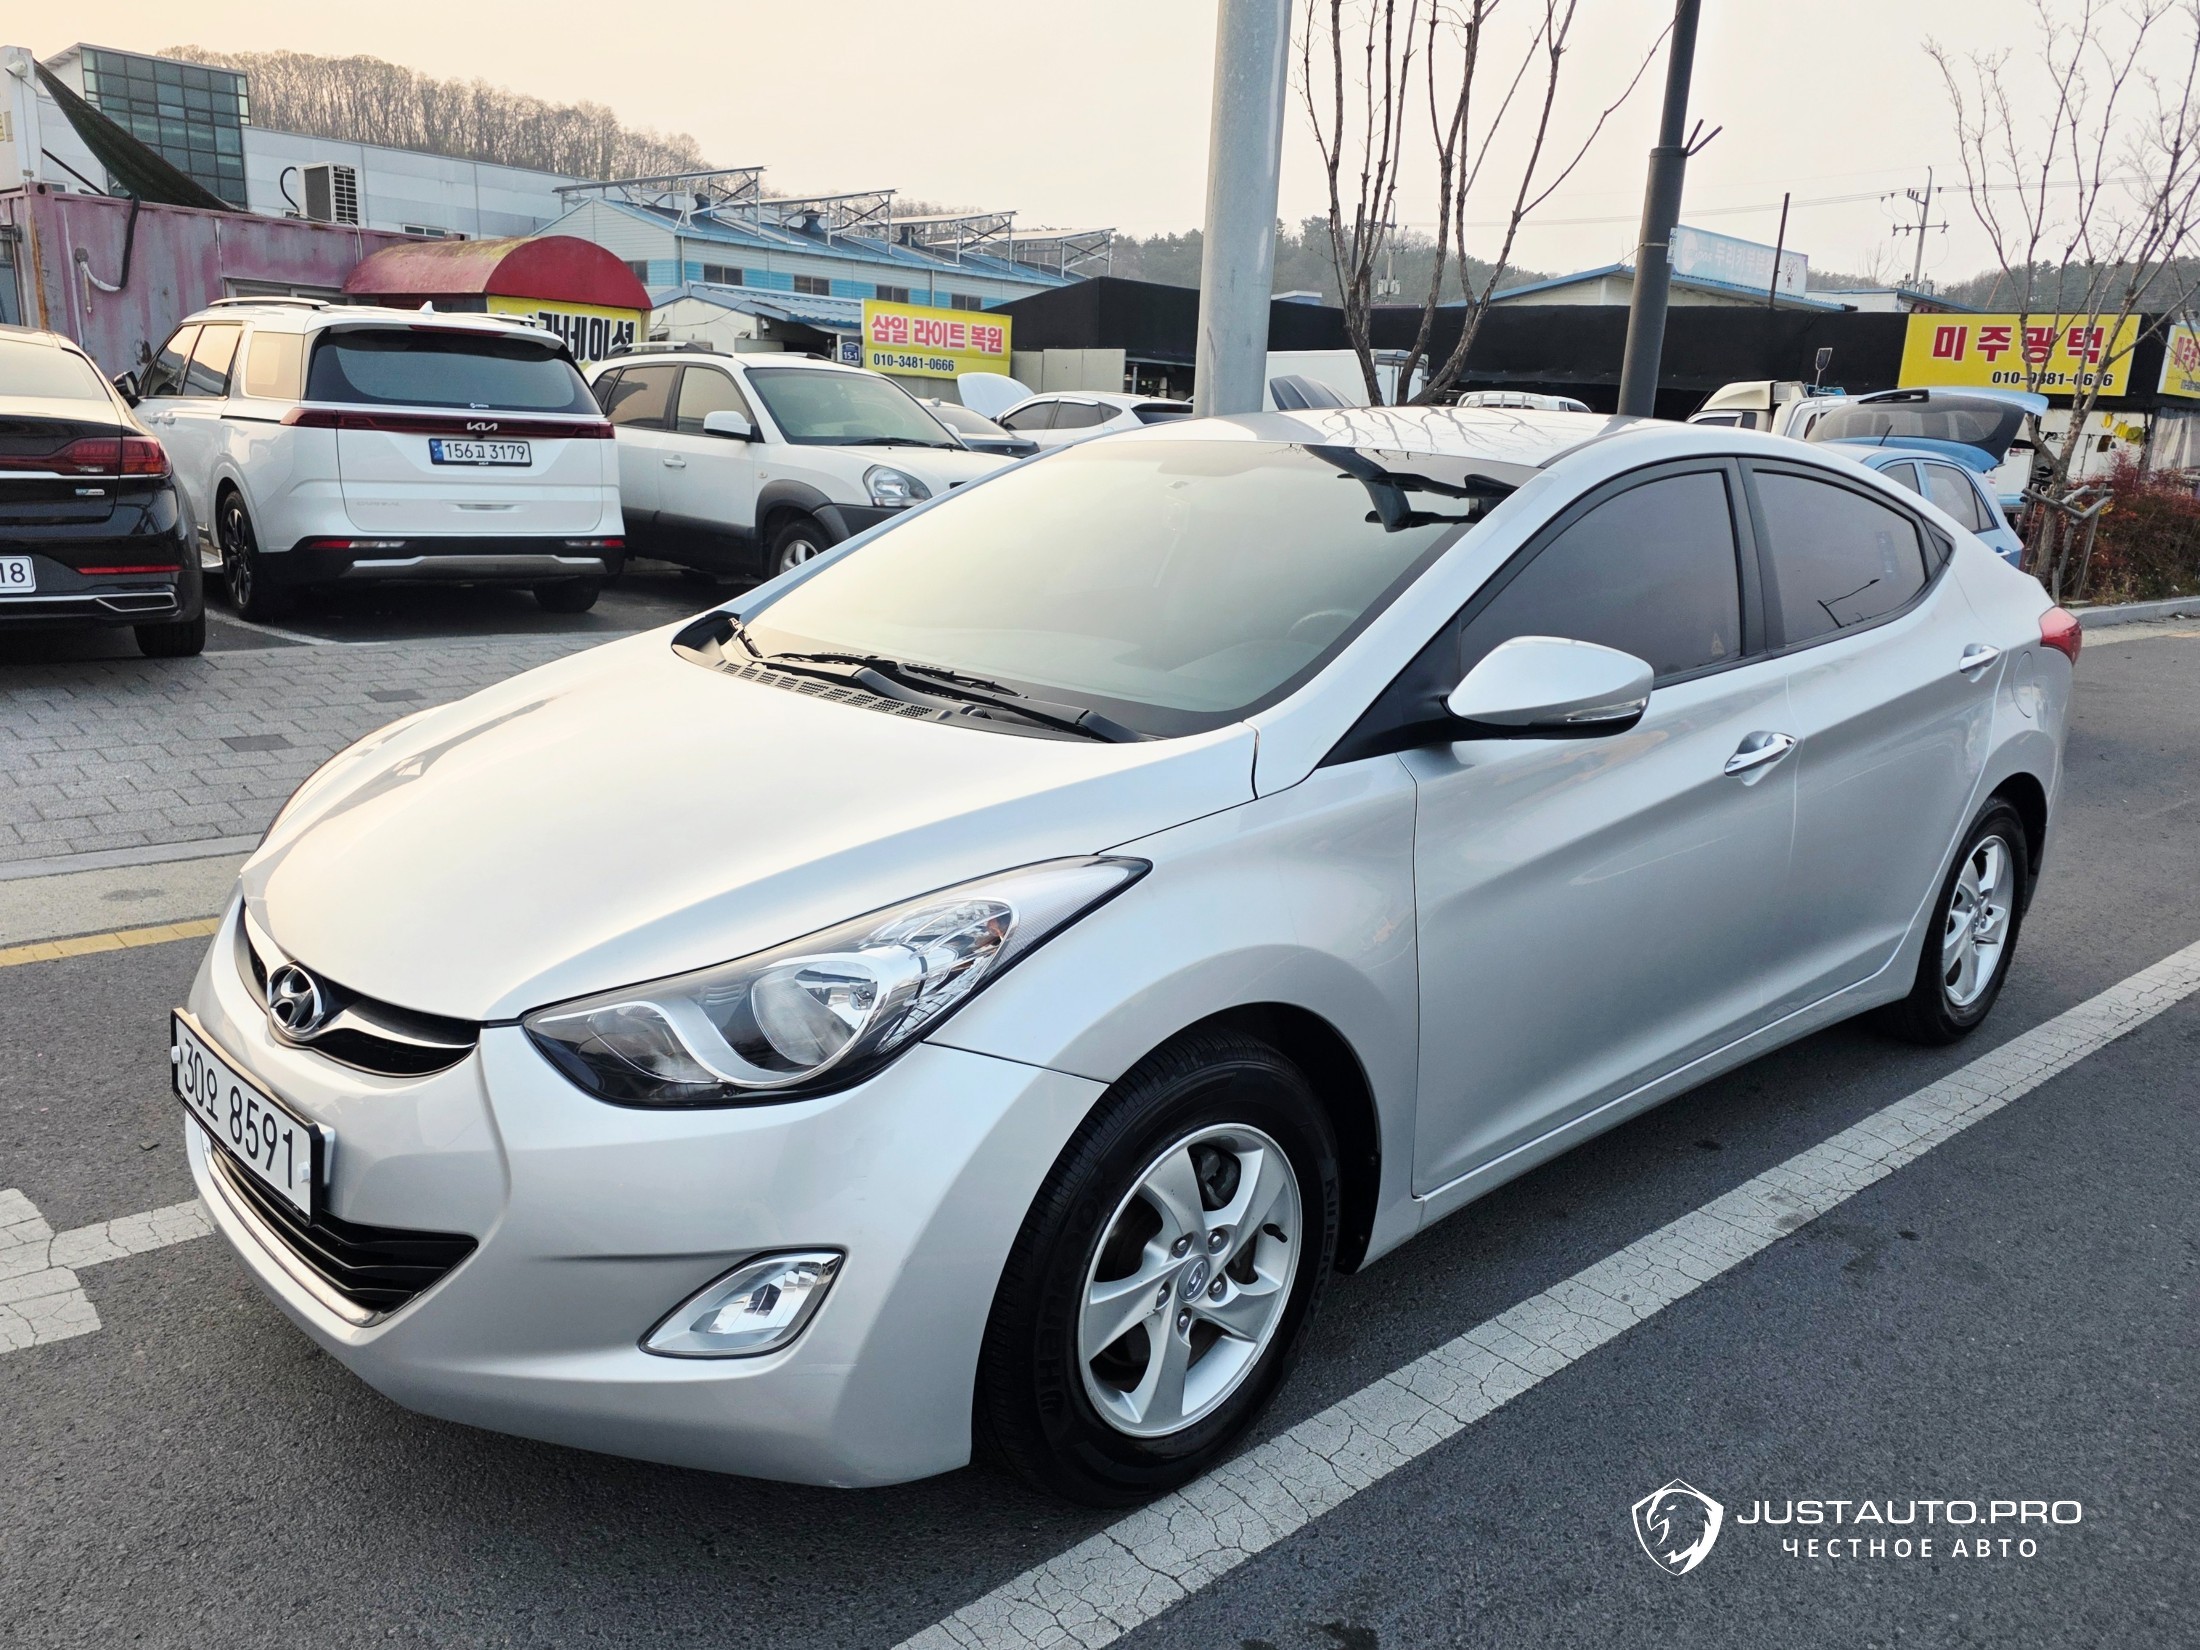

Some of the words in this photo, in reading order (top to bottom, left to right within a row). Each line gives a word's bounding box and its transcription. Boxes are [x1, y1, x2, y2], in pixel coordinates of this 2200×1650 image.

[871, 314, 908, 344] 삼일
[913, 319, 965, 349] 라이트
[971, 325, 1002, 353] 복원
[843, 351, 858, 360] 15-1
[873, 353, 954, 372] 010-3481-0666
[489, 444, 526, 460] 3179
[184, 1038, 219, 1123] 30오
[229, 1085, 293, 1190] 8591
